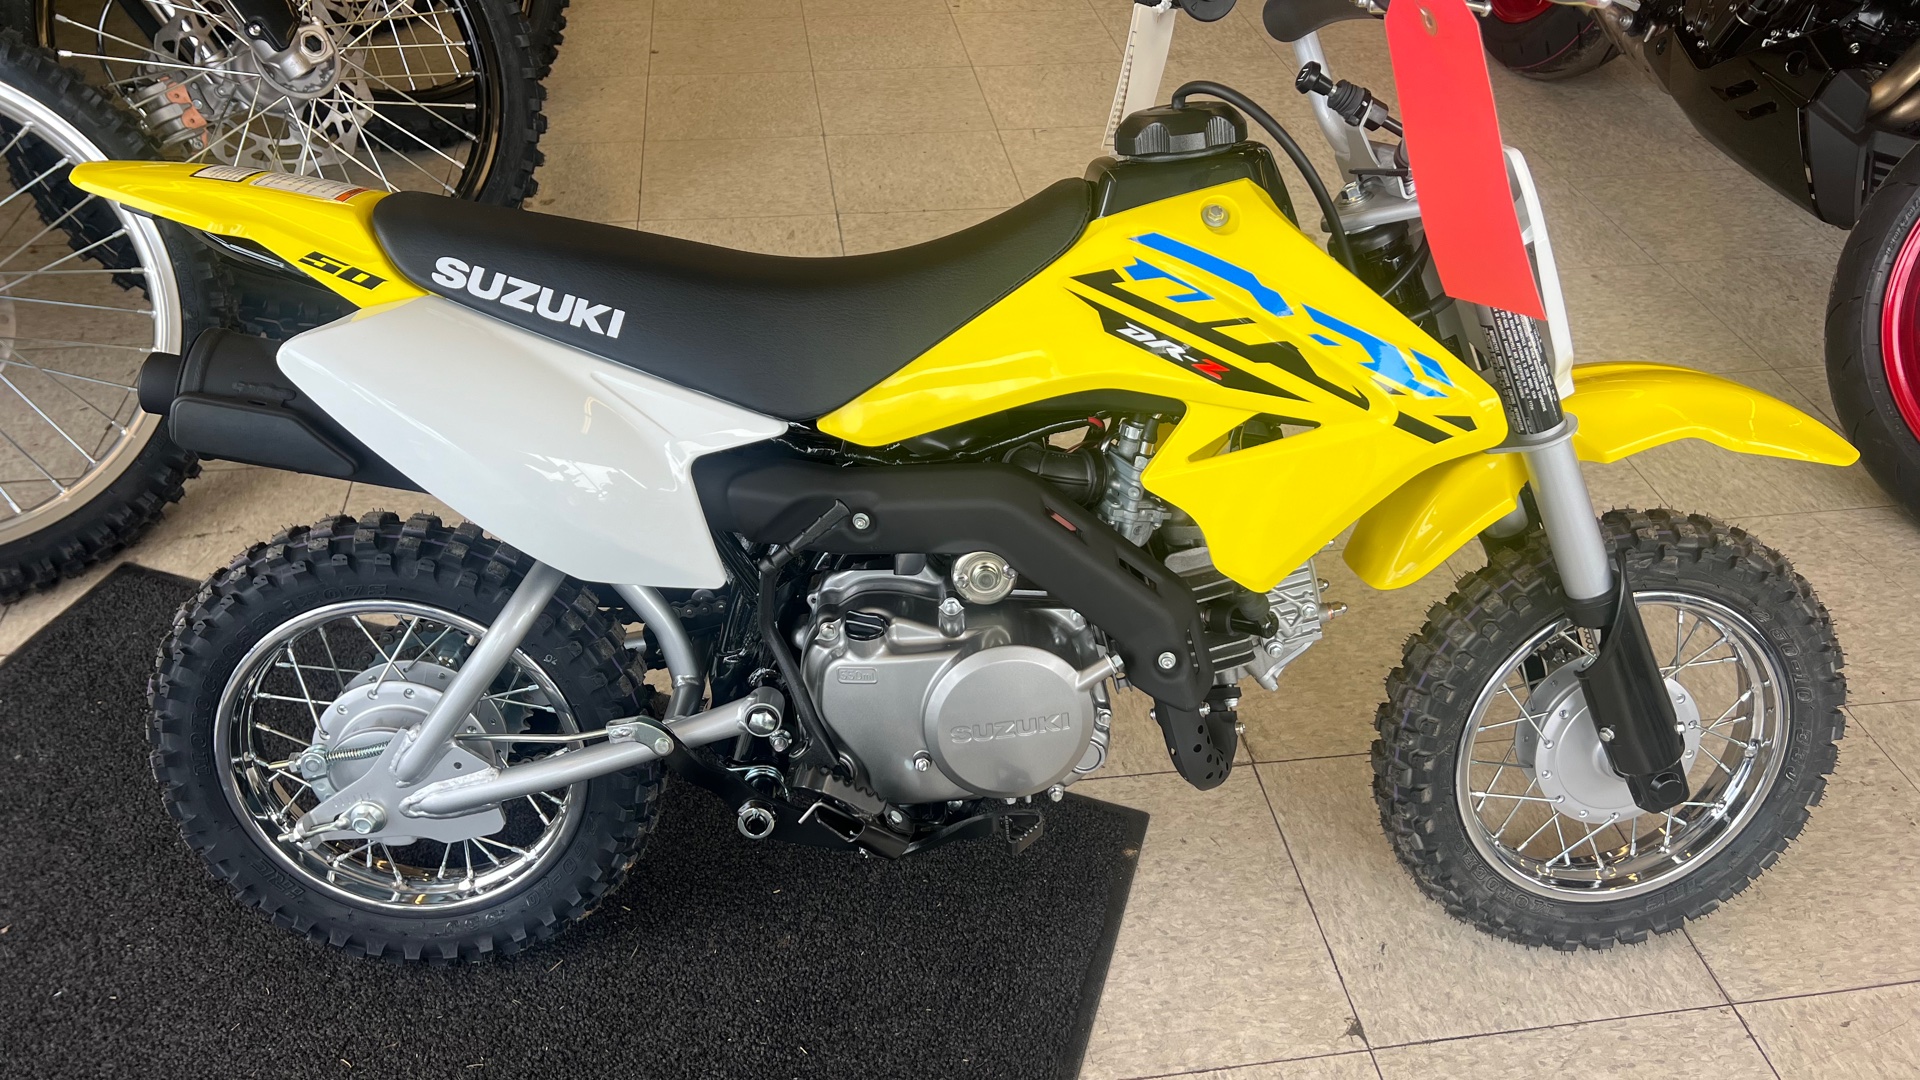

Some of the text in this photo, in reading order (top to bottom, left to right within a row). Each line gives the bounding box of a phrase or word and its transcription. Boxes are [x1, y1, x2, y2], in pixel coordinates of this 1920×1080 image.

[298, 251, 388, 290] 50
[431, 256, 626, 339] SUZUKI
[1116, 322, 1230, 380] DR-Z
[950, 712, 1071, 743] SUZUKI
